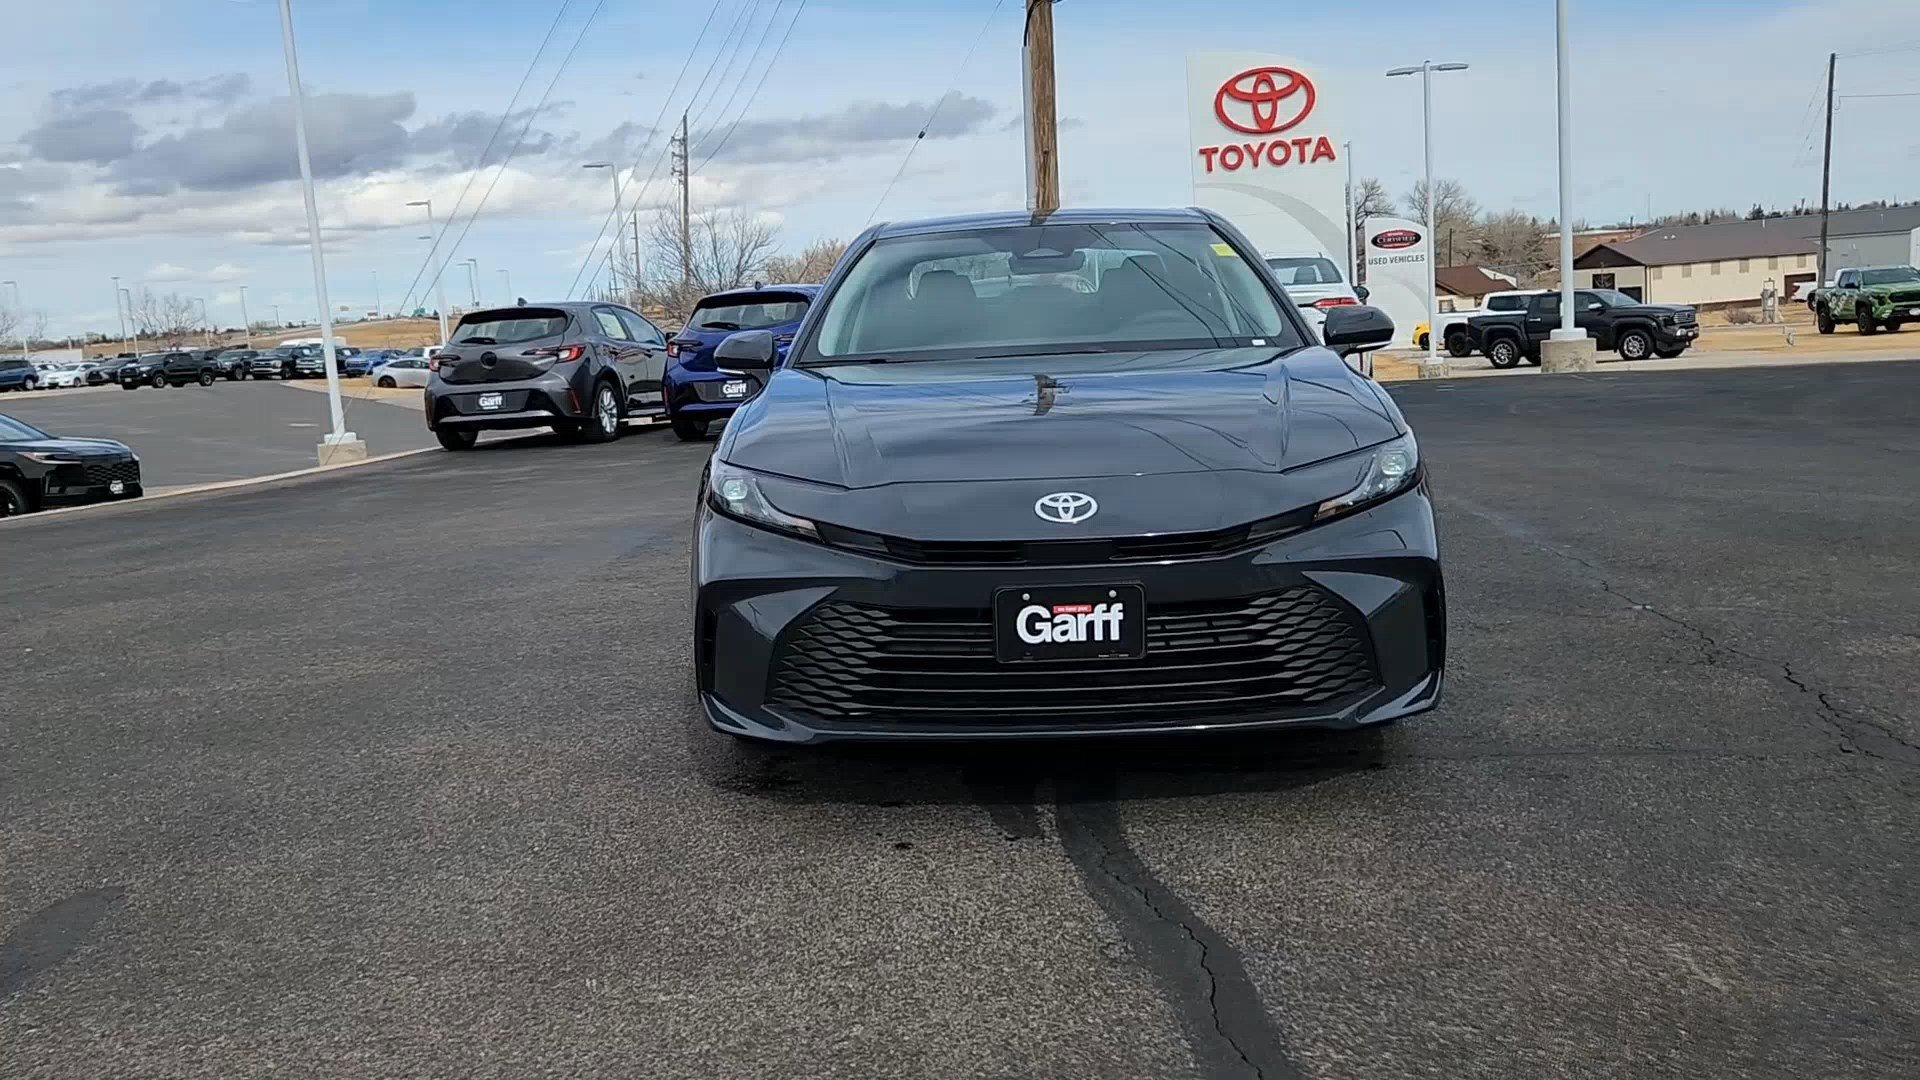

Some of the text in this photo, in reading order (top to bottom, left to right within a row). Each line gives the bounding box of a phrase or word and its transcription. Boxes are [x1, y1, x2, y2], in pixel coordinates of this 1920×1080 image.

[1199, 136, 1336, 172] TOYOTA
[1368, 254, 1425, 266] USED VEHICLES
[1016, 603, 1124, 644] Garff
